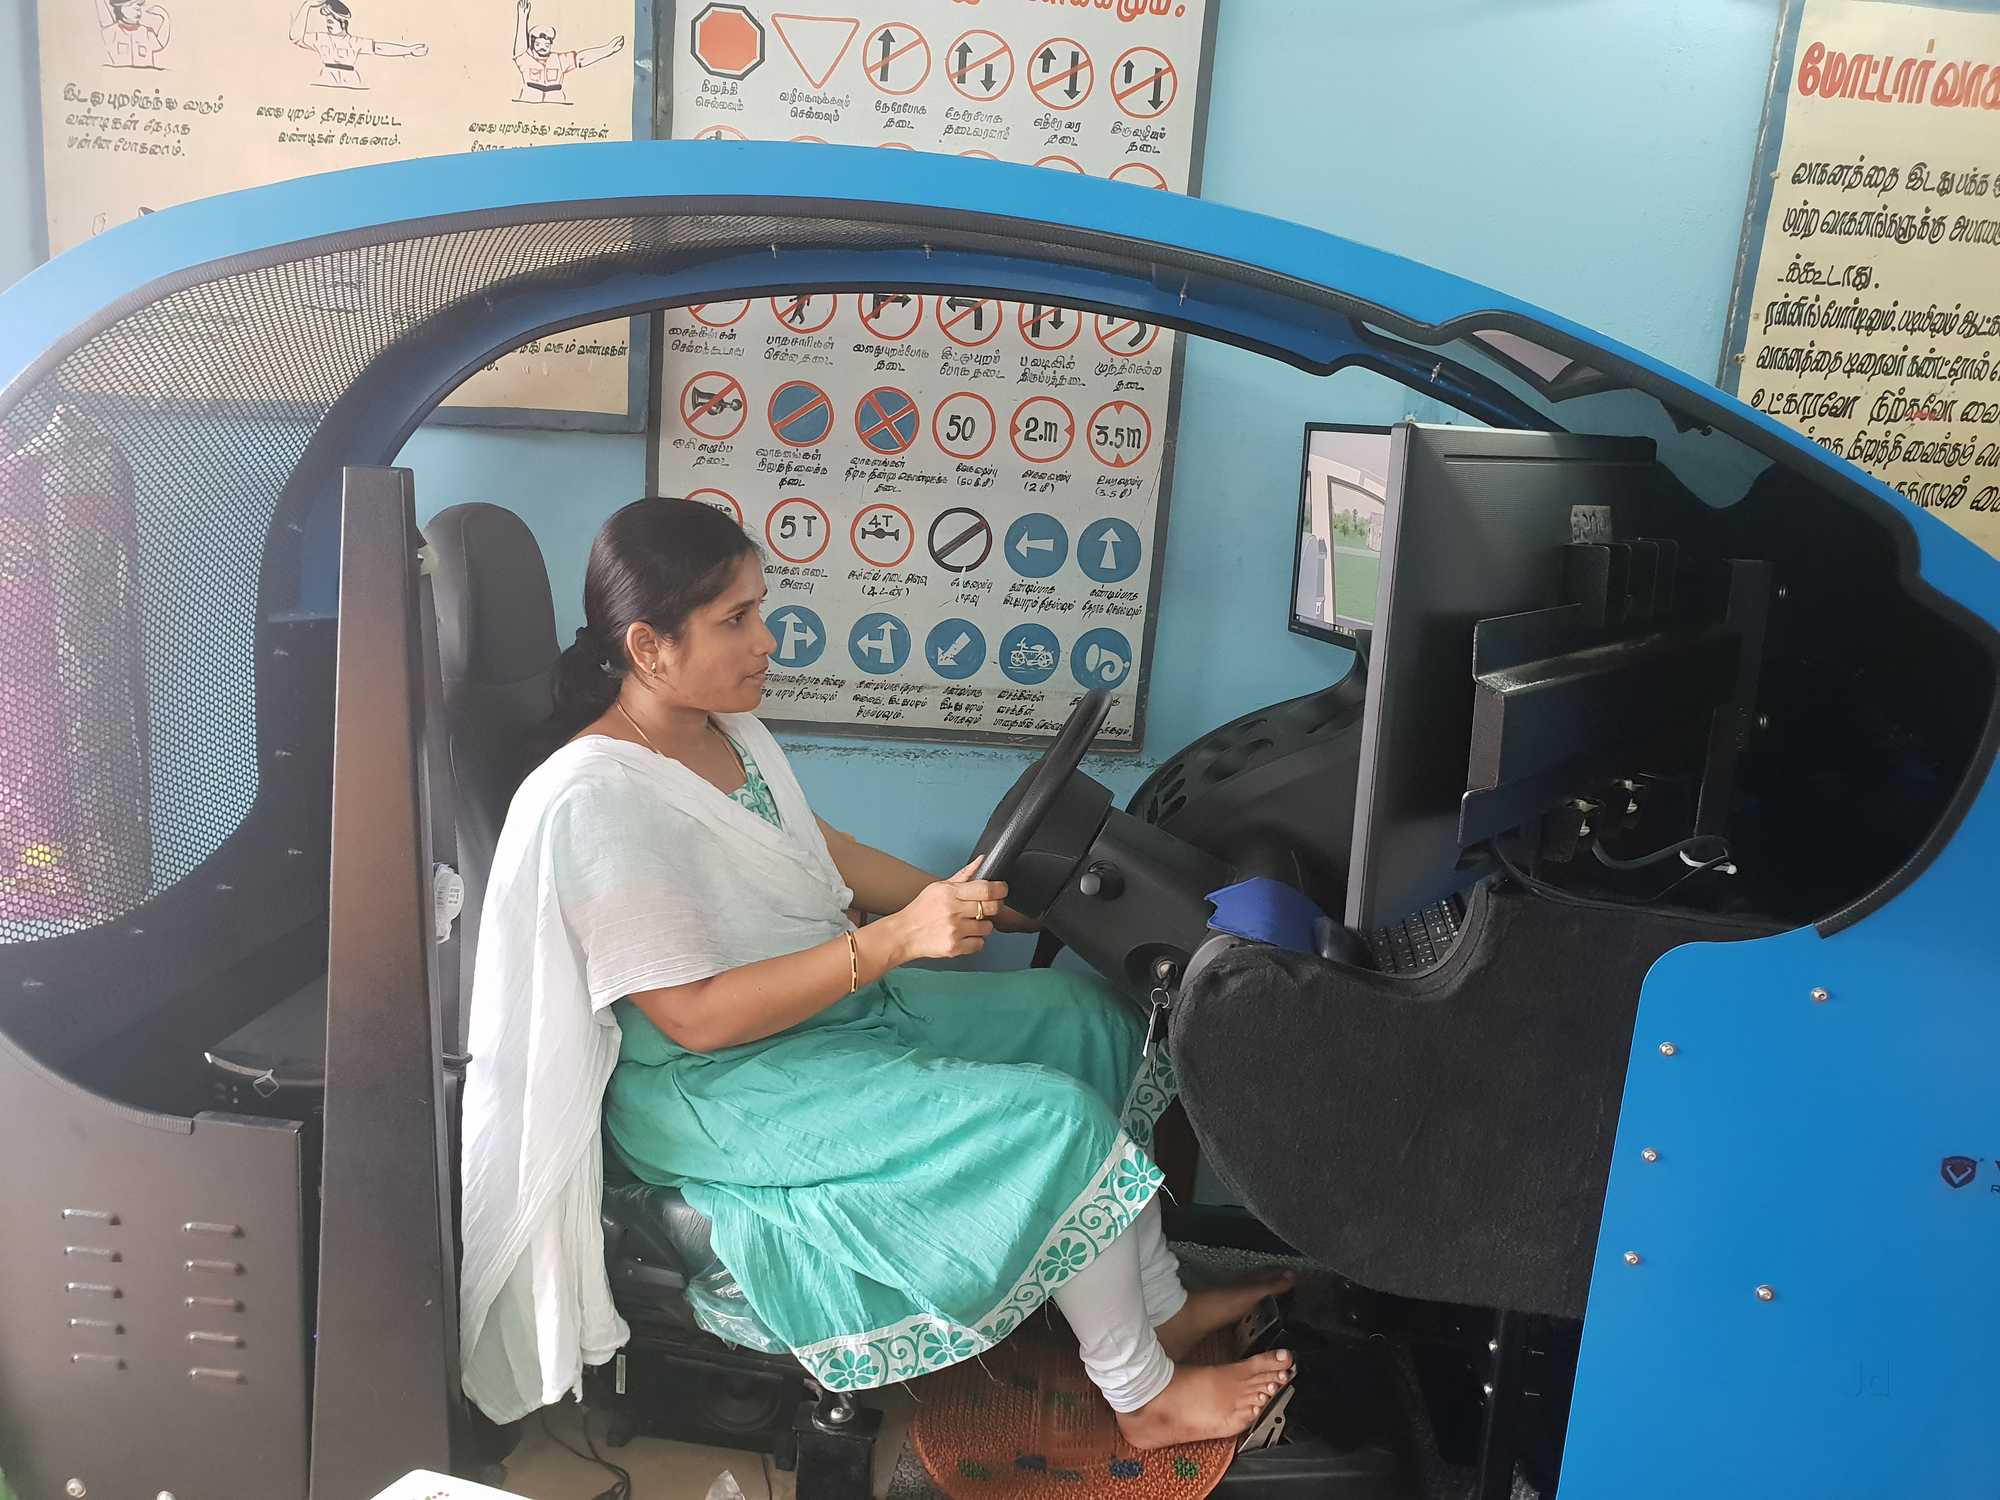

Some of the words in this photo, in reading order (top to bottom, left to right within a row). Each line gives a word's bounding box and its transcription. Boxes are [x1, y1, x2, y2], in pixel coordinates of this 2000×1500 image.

[1797, 38, 1937, 104] மோட்டார்
[701, 79, 738, 97] நிறுத்தி
[63, 82, 105, 108] இடது
[183, 95, 225, 115] வரும்
[695, 96, 745, 113] செல்லவும்
[790, 106, 841, 124] செல்லவும்
[883, 118, 915, 129] தடை
[1043, 134, 1078, 147] தடை
[1125, 142, 1161, 154] தடை
[1791, 154, 1901, 198] வாகனத்தை
[1782, 200, 1820, 240] மற்ற
[873, 360, 906, 372] தடை
[1755, 340, 1843, 381] வாகனத்தை
[1113, 380, 1145, 393] தடை
[946, 415, 976, 442] 50
[1094, 424, 1142, 450] 3.5m
[692, 456, 731, 468] தடை
[777, 477, 806, 490] தடை
[868, 515, 894, 528] 4T
